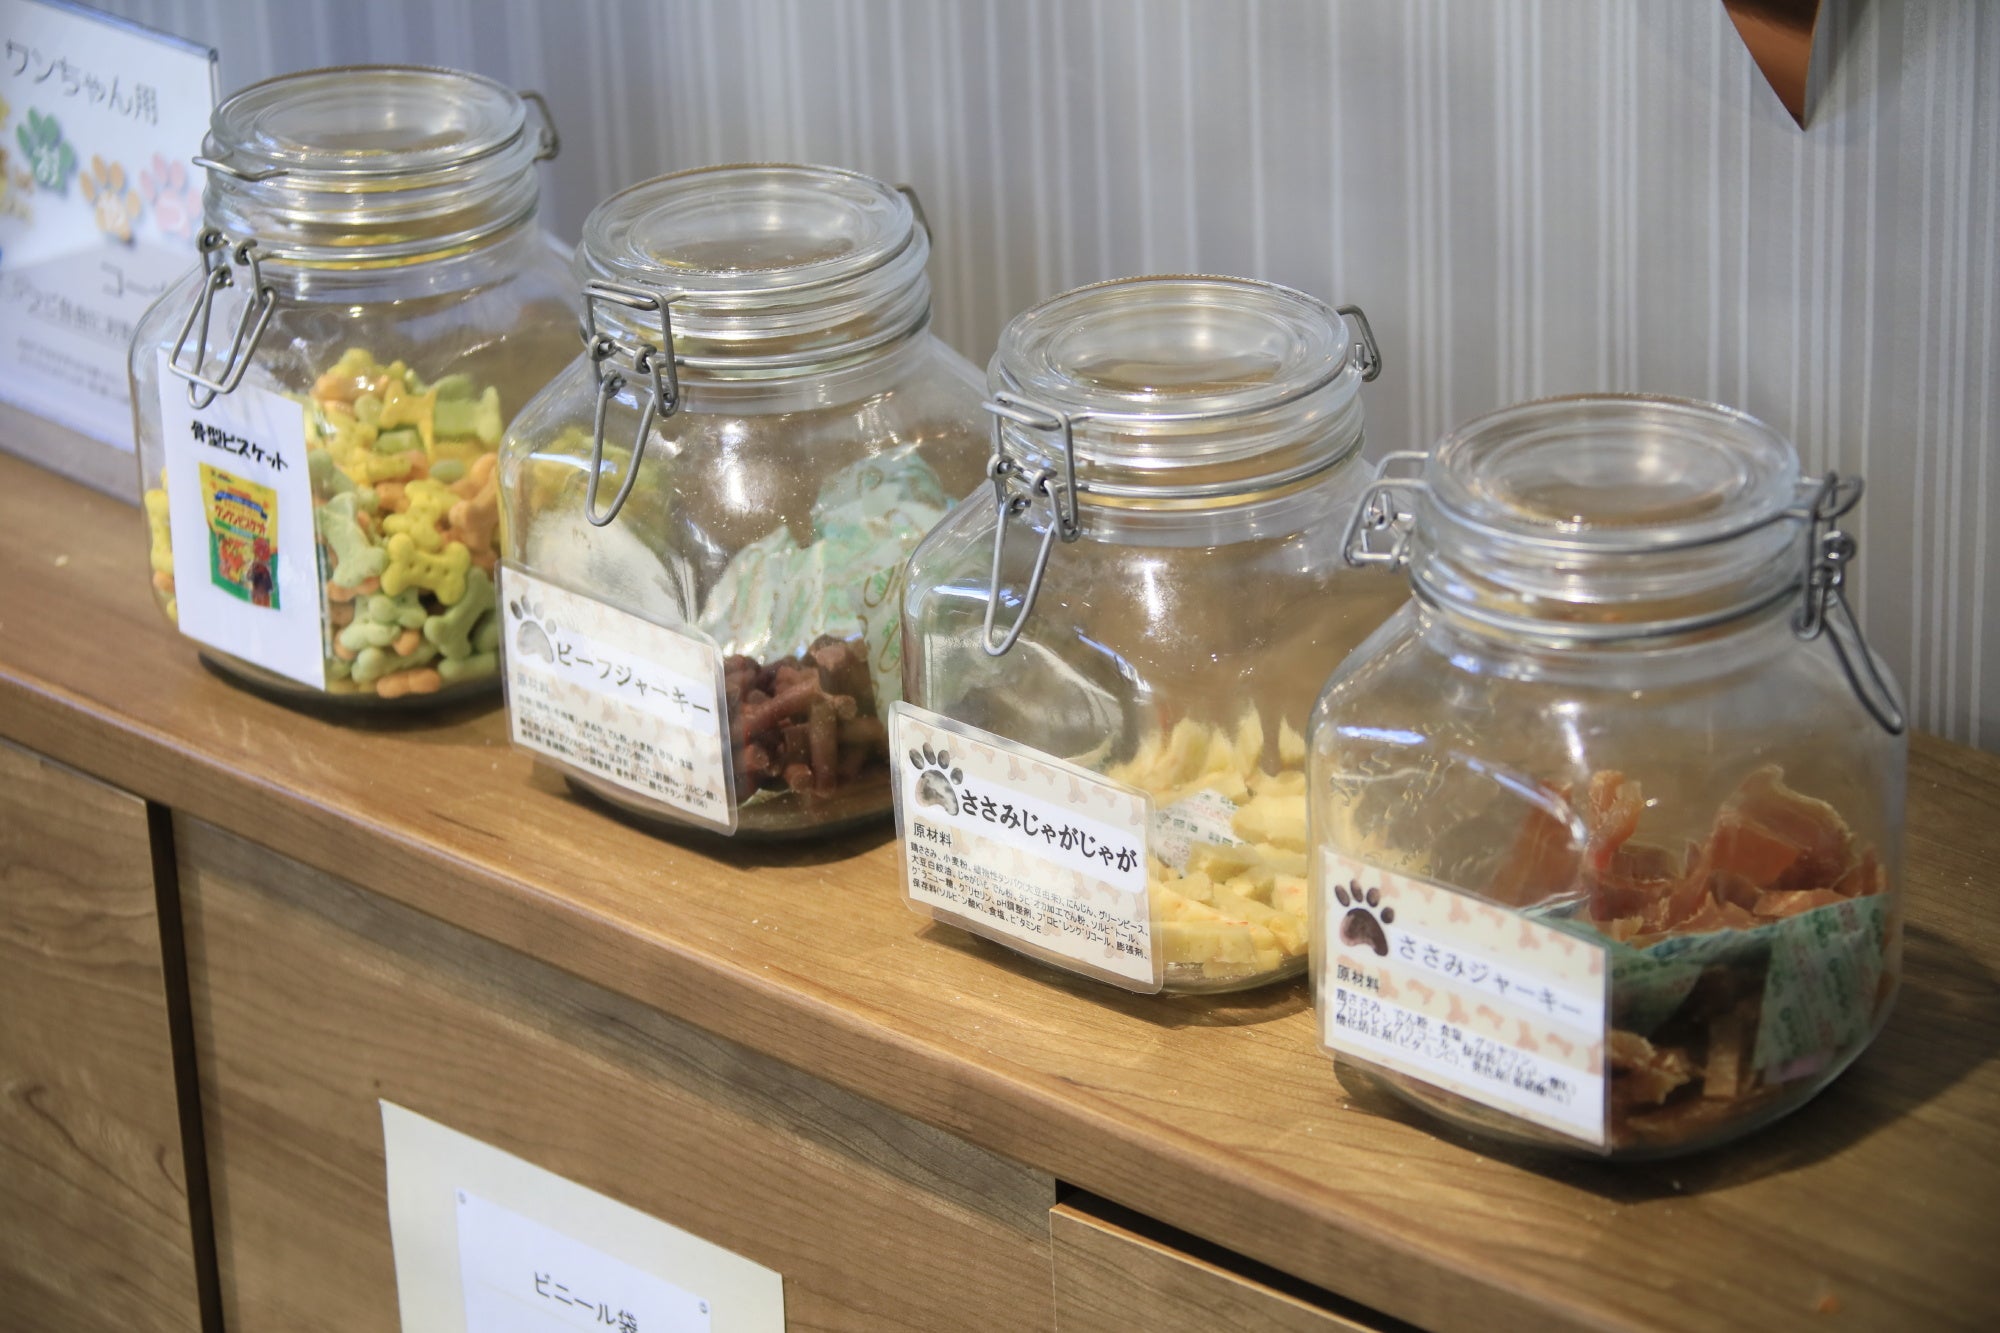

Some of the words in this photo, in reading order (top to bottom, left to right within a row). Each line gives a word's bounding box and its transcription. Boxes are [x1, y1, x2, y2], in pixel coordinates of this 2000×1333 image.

[6, 38, 160, 126] ワンちゃん用
[191, 420, 288, 471] 骨型ビスケット
[558, 641, 710, 713] ビーフジャーキー
[913, 822, 952, 848] 原材料
[962, 789, 1137, 872] ささみじゃがじゃが
[1337, 964, 1380, 992] 原材料
[1400, 935, 1582, 1015] ささみジャーキー
[534, 1271, 639, 1333] ビニール袋
